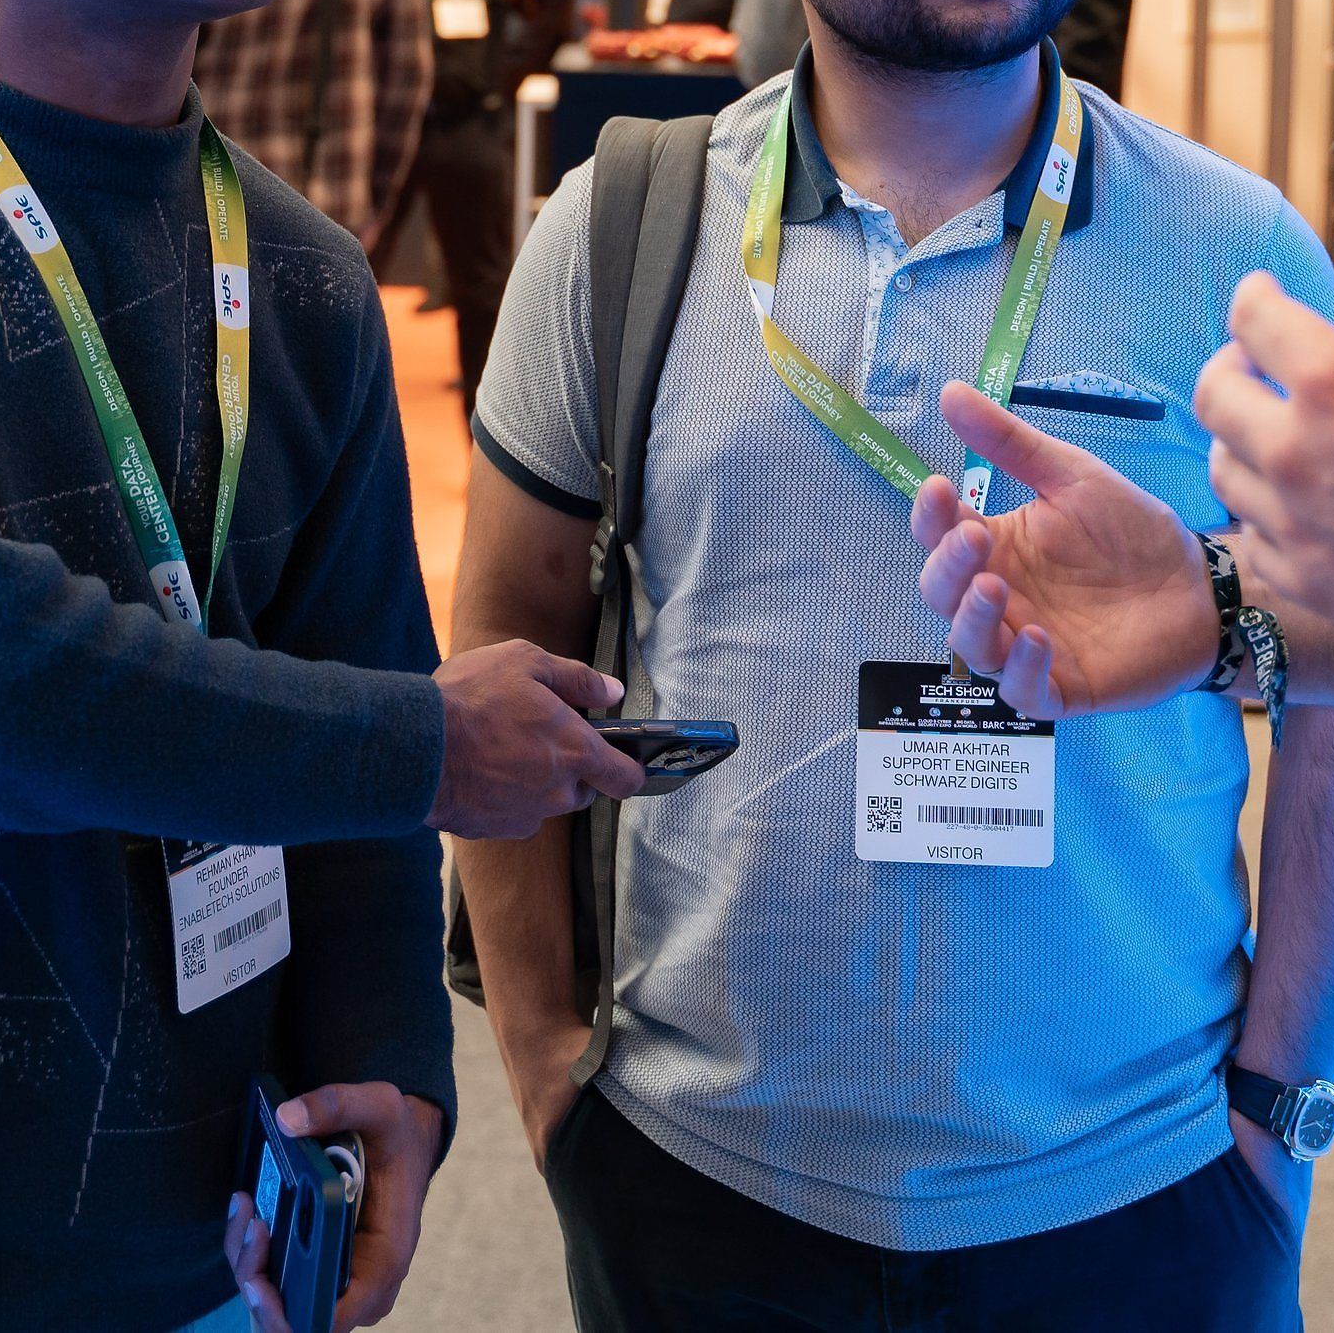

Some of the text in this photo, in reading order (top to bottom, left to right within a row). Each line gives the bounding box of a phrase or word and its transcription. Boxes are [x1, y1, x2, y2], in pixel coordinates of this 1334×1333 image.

[213, 167, 224, 192] BUILD
[216, 196, 228, 241] OPERATE
[753, 220, 764, 259] OPERATE
[1010, 218, 1052, 332] DESIGN BUILD OPERATE
[56, 274, 118, 412] DESIGN BUILD OPERATE
[772, 350, 842, 422] CENTER JOURNEY
[786, 354, 834, 404] YOUR DATA
[993, 351, 1012, 395] JOURNEY
[222, 354, 236, 458] CENTER JOURNEY
[232, 375, 244, 442] YOUR DATA
[859, 432, 922, 487] DESIGN BUILD
[120, 456, 151, 529] YOUR DATA
[123, 435, 171, 544] CENTER JOURNEY
[920, 684, 995, 698] TECH SHOW
[982, 720, 1005, 730] BARC
[882, 756, 1030, 774] SUPPORT ENGINEER
[903, 740, 1010, 756] UMAIR AKHTAR
[894, 774, 1018, 790] SCHWARZ DIGITS
[196, 858, 232, 886] REHMAN
[233, 844, 256, 868] KHAN
[926, 846, 983, 860] VISITOR
[179, 866, 281, 932] ENABLETECH SOLUTIONS
[208, 865, 249, 898] FOUNDER
[223, 958, 257, 986] VISITOR
